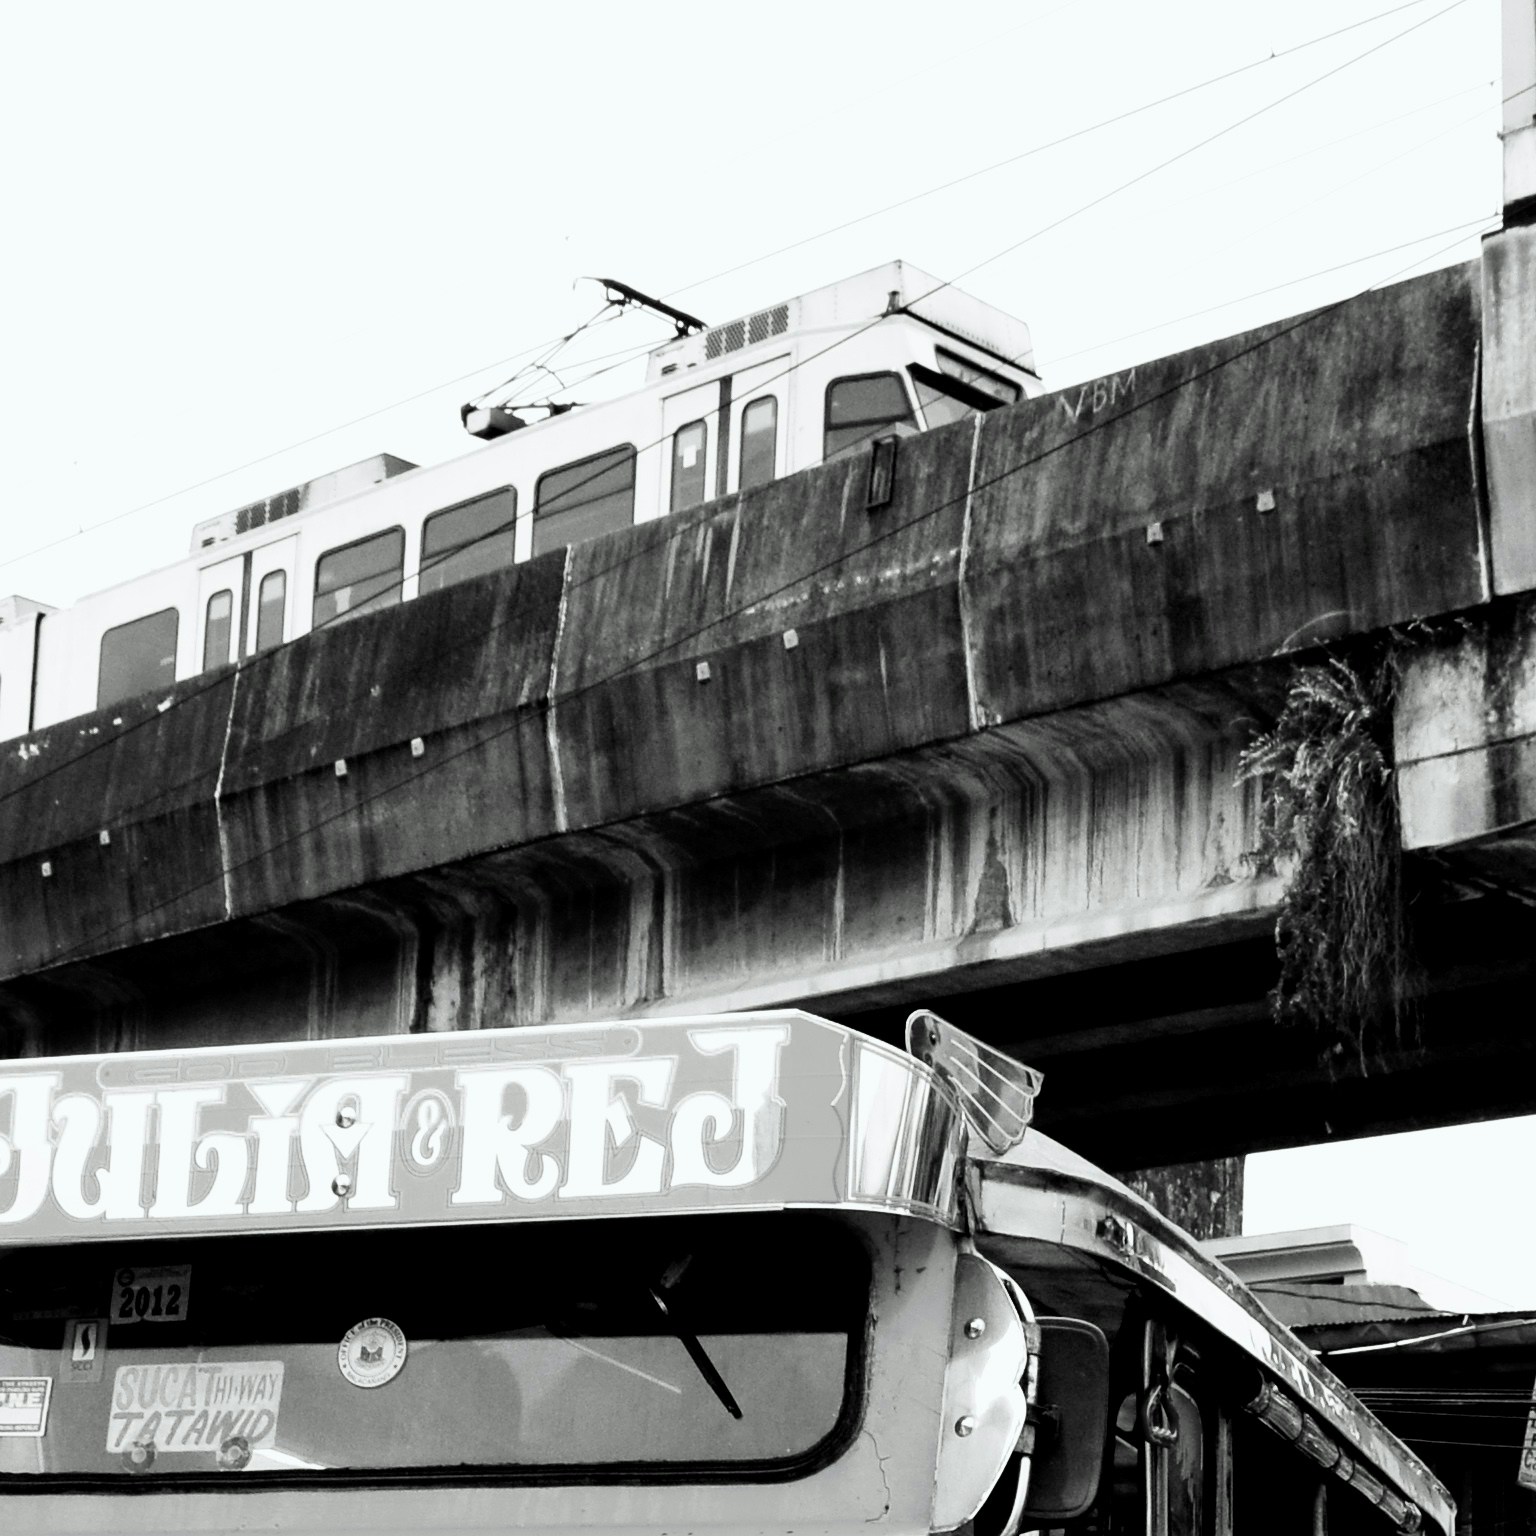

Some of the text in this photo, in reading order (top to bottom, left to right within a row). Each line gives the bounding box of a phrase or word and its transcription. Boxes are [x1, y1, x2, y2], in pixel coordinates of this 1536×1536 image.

[412, 1100, 442, 1167] &
[450, 1028, 791, 1204] REJ
[118, 1283, 181, 1318] 2012
[115, 1365, 222, 1411] SUCAT
[113, 1408, 276, 1447] TATAWID
